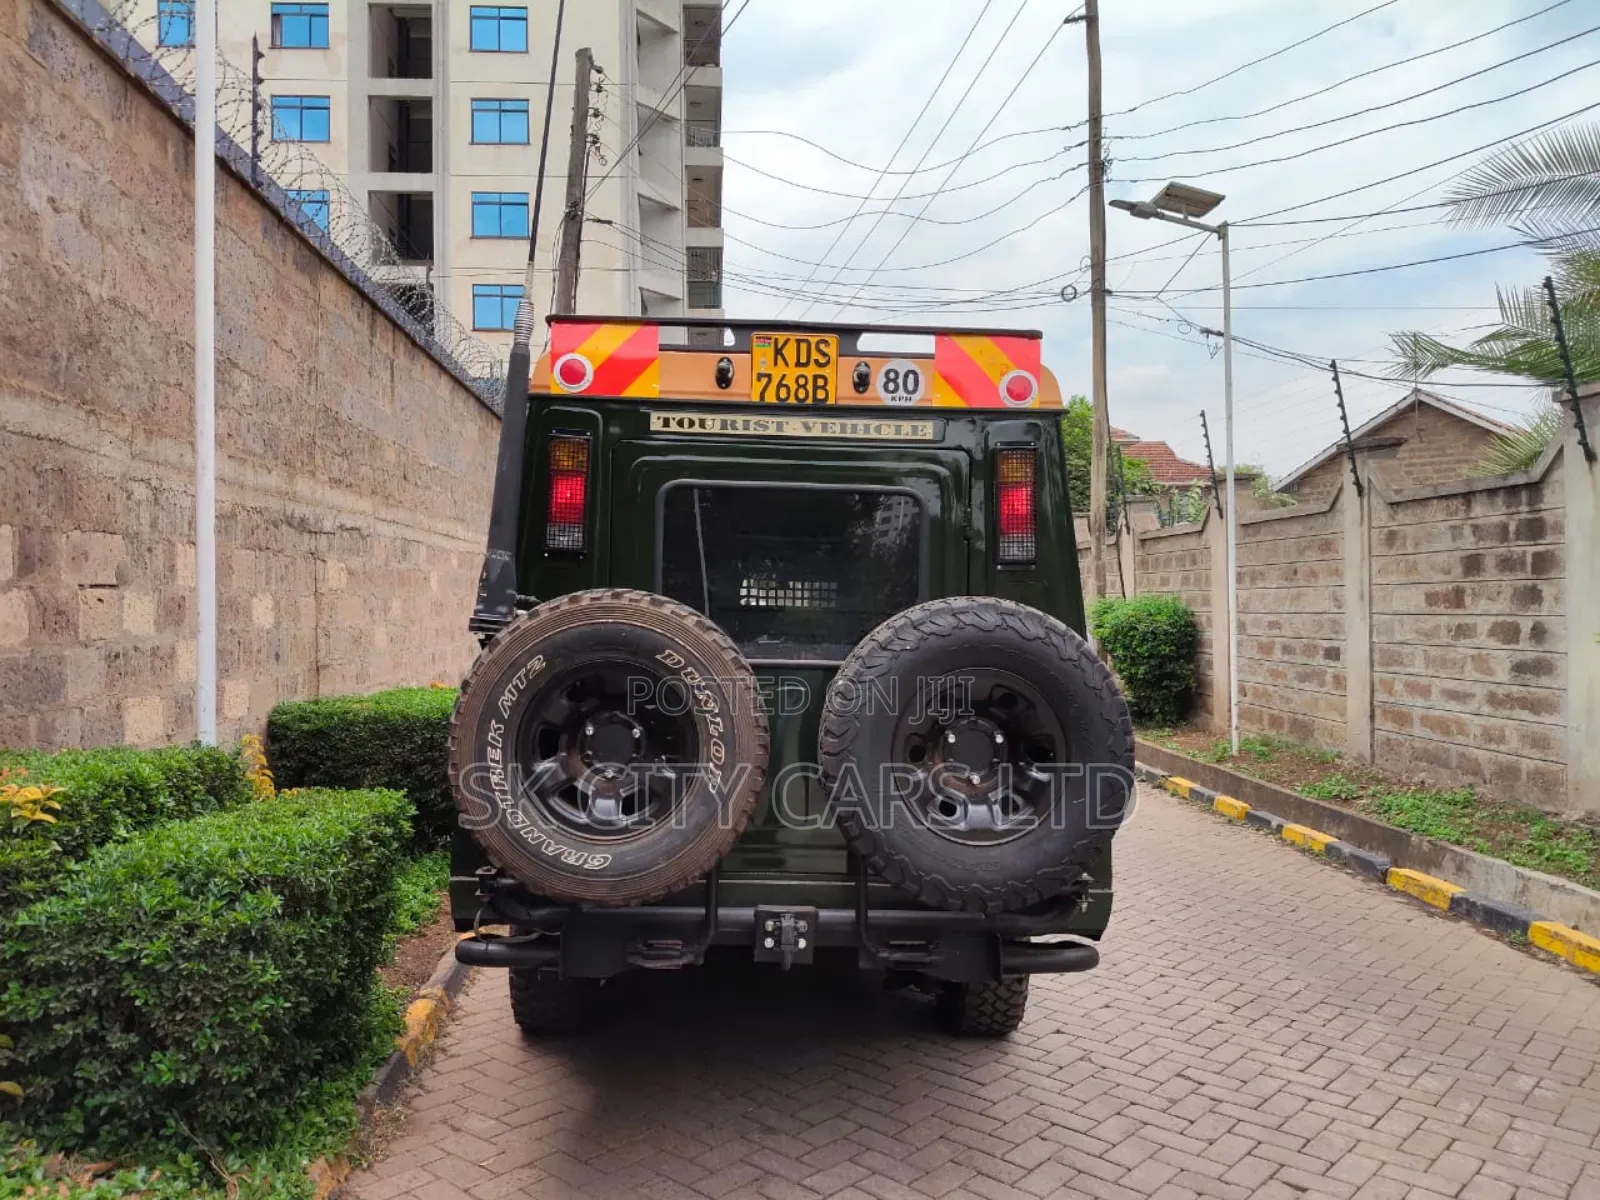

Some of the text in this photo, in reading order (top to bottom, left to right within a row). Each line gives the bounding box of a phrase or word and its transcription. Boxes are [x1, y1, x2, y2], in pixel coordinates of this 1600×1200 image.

[773, 337, 831, 368] KDS
[756, 372, 830, 404] 768B
[883, 368, 920, 395] 80
[890, 395, 913, 403] KPH
[657, 415, 928, 437] TOURIST VEHICLE
[655, 649, 725, 794] DUNLOP
